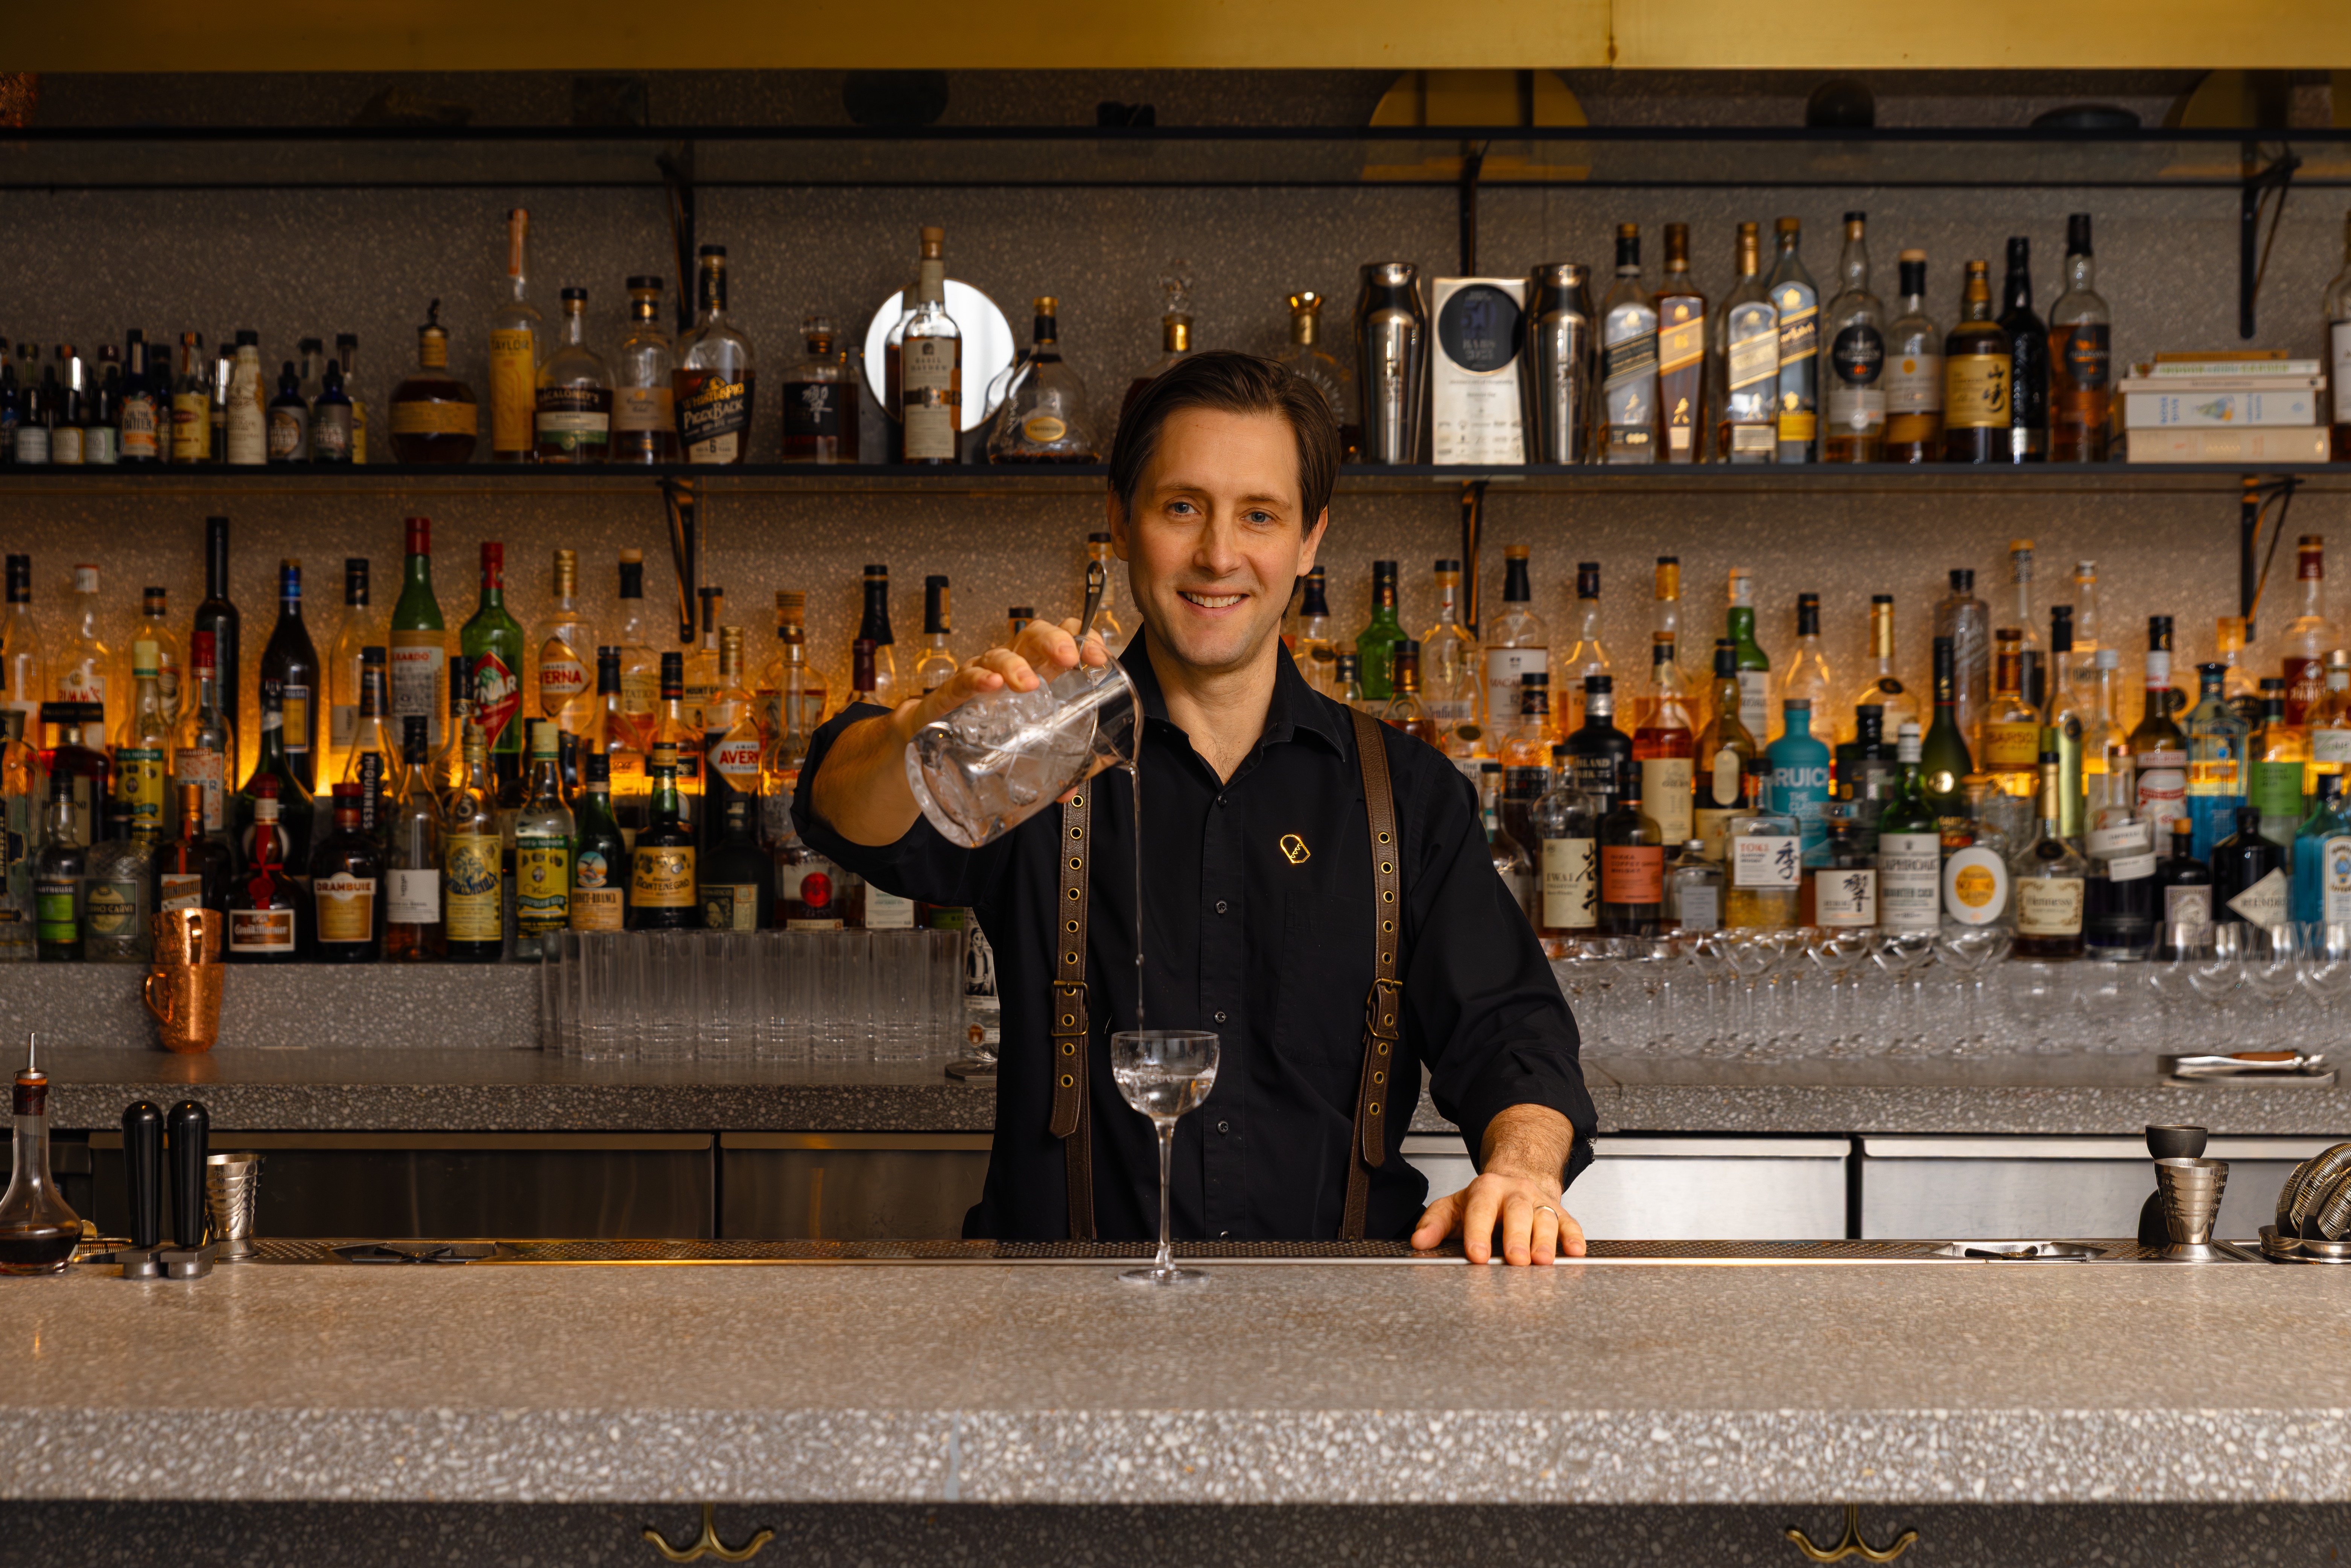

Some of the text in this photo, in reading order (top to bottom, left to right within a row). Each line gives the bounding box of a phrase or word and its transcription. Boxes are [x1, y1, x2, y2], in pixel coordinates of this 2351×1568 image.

[1740, 843, 1770, 852] TOKI
[1547, 873, 1573, 882] IWAI
[316, 881, 371, 891] DRAMBUIE
